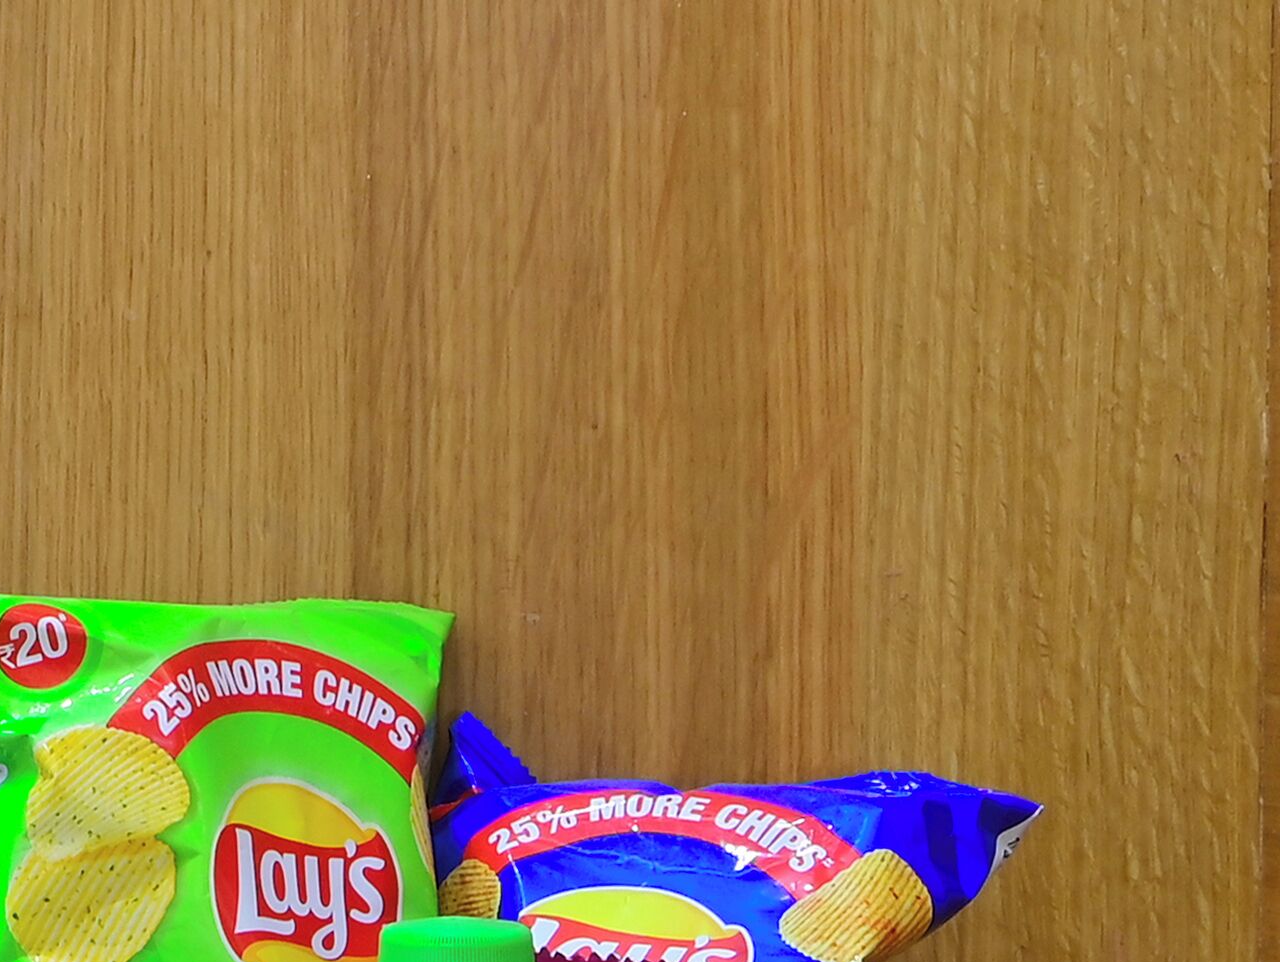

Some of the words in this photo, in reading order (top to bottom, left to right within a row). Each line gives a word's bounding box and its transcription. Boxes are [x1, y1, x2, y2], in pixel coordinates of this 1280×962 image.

[142, 668, 210, 736] 25%
[206, 658, 302, 698] MORE
[313, 669, 417, 751] CHIPS
[487, 805, 577, 855] 25%
[590, 794, 711, 821] MORE
[714, 803, 827, 873] CHIPS
[234, 828, 385, 959] Lay's
